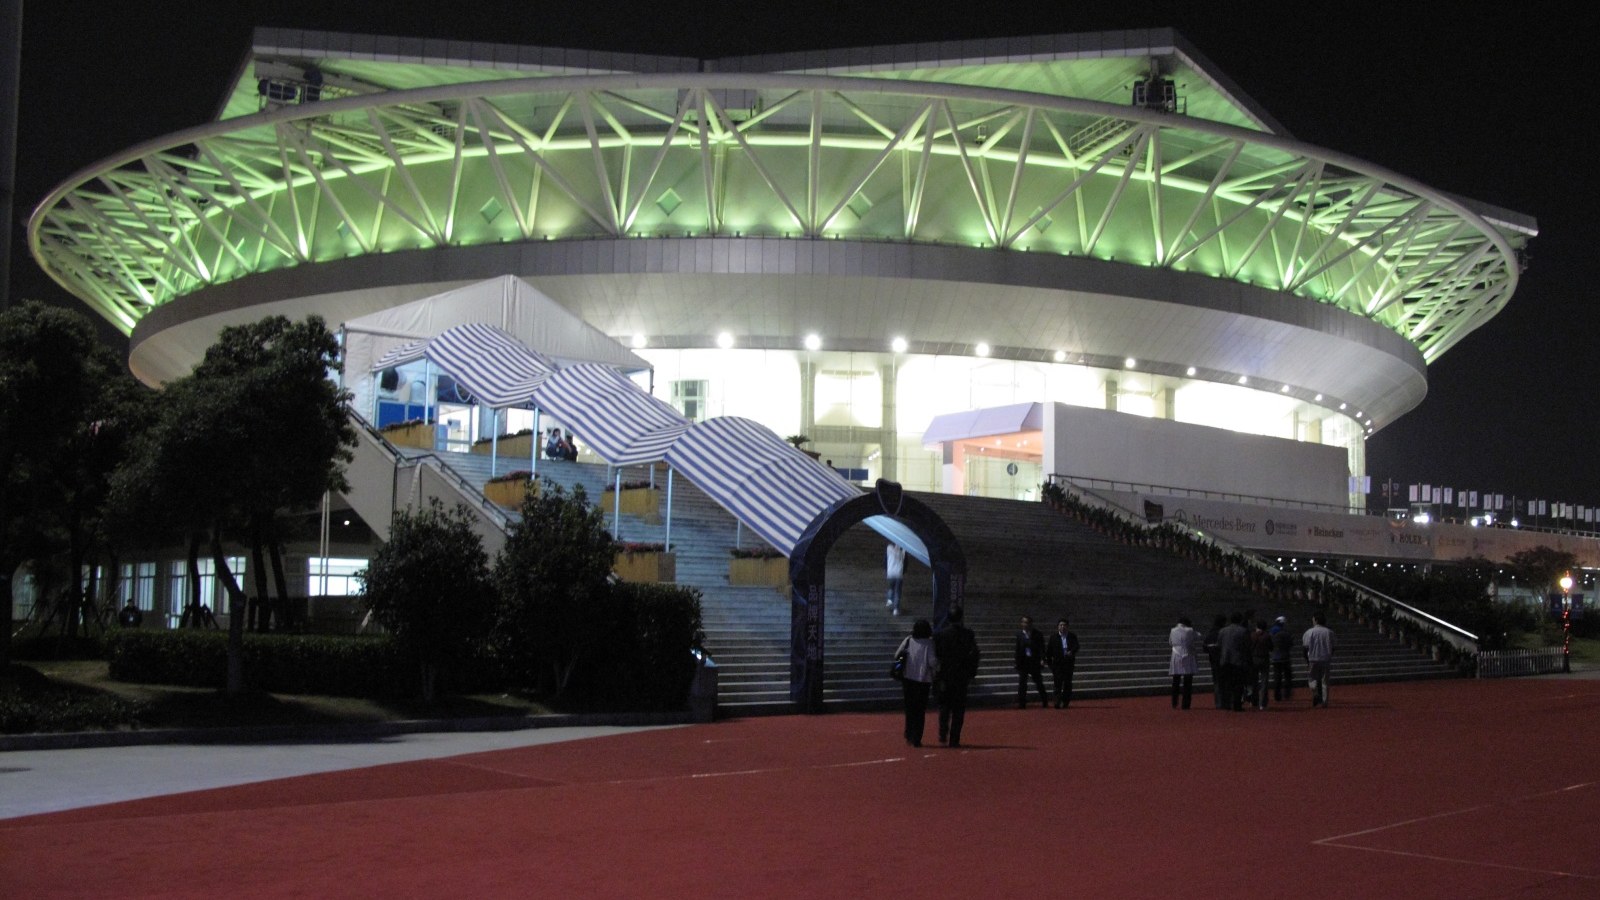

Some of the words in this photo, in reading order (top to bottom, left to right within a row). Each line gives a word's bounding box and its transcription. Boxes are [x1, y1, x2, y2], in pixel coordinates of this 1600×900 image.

[1193, 514, 1256, 533] Mercedes-Benz
[1314, 526, 1344, 538] Heineken
[1399, 533, 1422, 545] ROLEX
